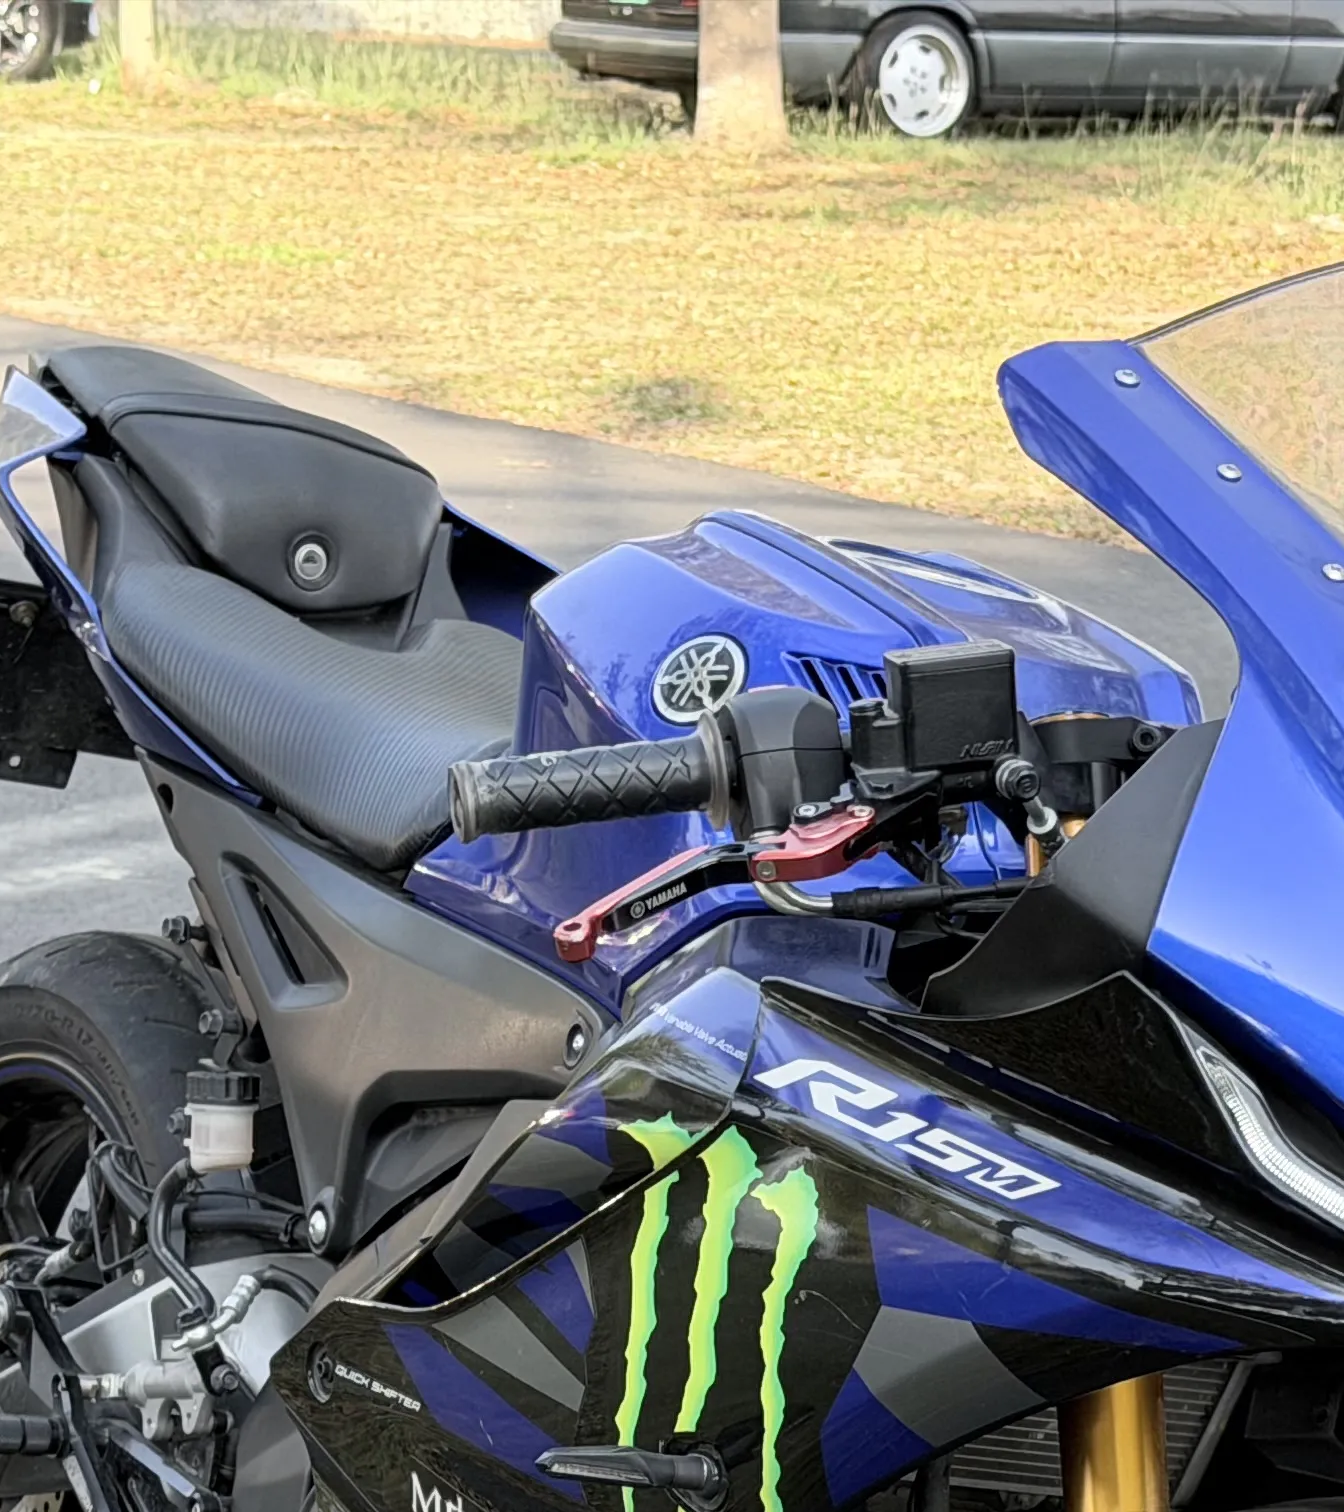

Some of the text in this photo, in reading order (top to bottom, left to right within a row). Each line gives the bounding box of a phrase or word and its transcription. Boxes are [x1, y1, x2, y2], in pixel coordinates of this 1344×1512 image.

[644, 881, 688, 911] YAMAHA
[753, 1058, 1062, 1200] R15M
[335, 1364, 422, 1413] QUICK SHIFTER
